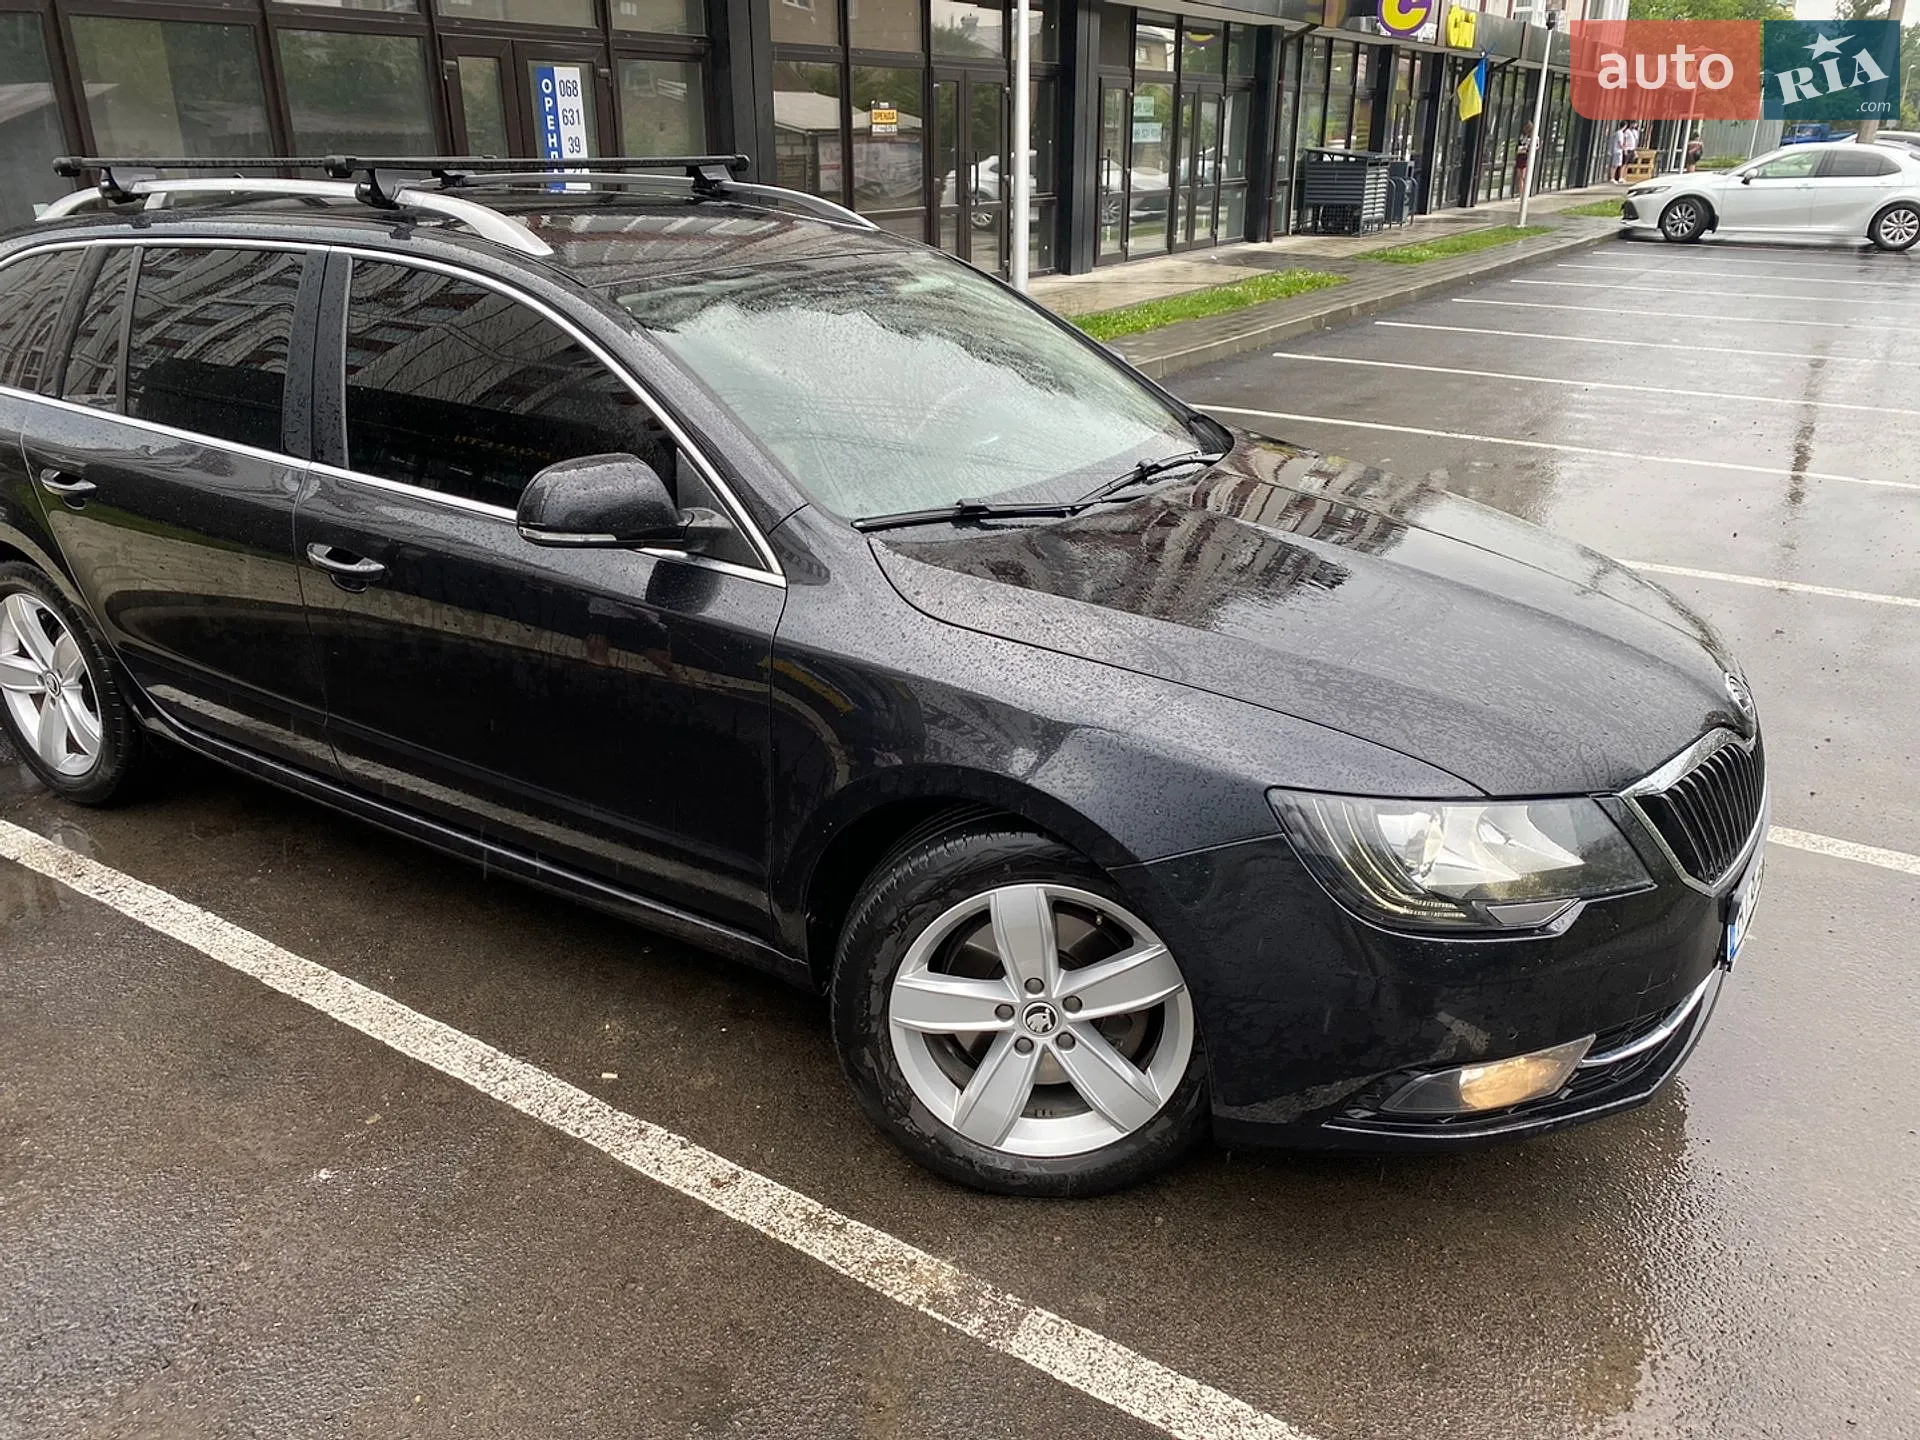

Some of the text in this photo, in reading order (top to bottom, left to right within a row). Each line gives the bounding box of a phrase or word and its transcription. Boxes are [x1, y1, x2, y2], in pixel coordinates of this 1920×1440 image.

[558, 79, 579, 97] 068
[541, 78, 559, 174] ОРЕН
[561, 108, 581, 126] 631
[568, 136, 581, 154] 39
